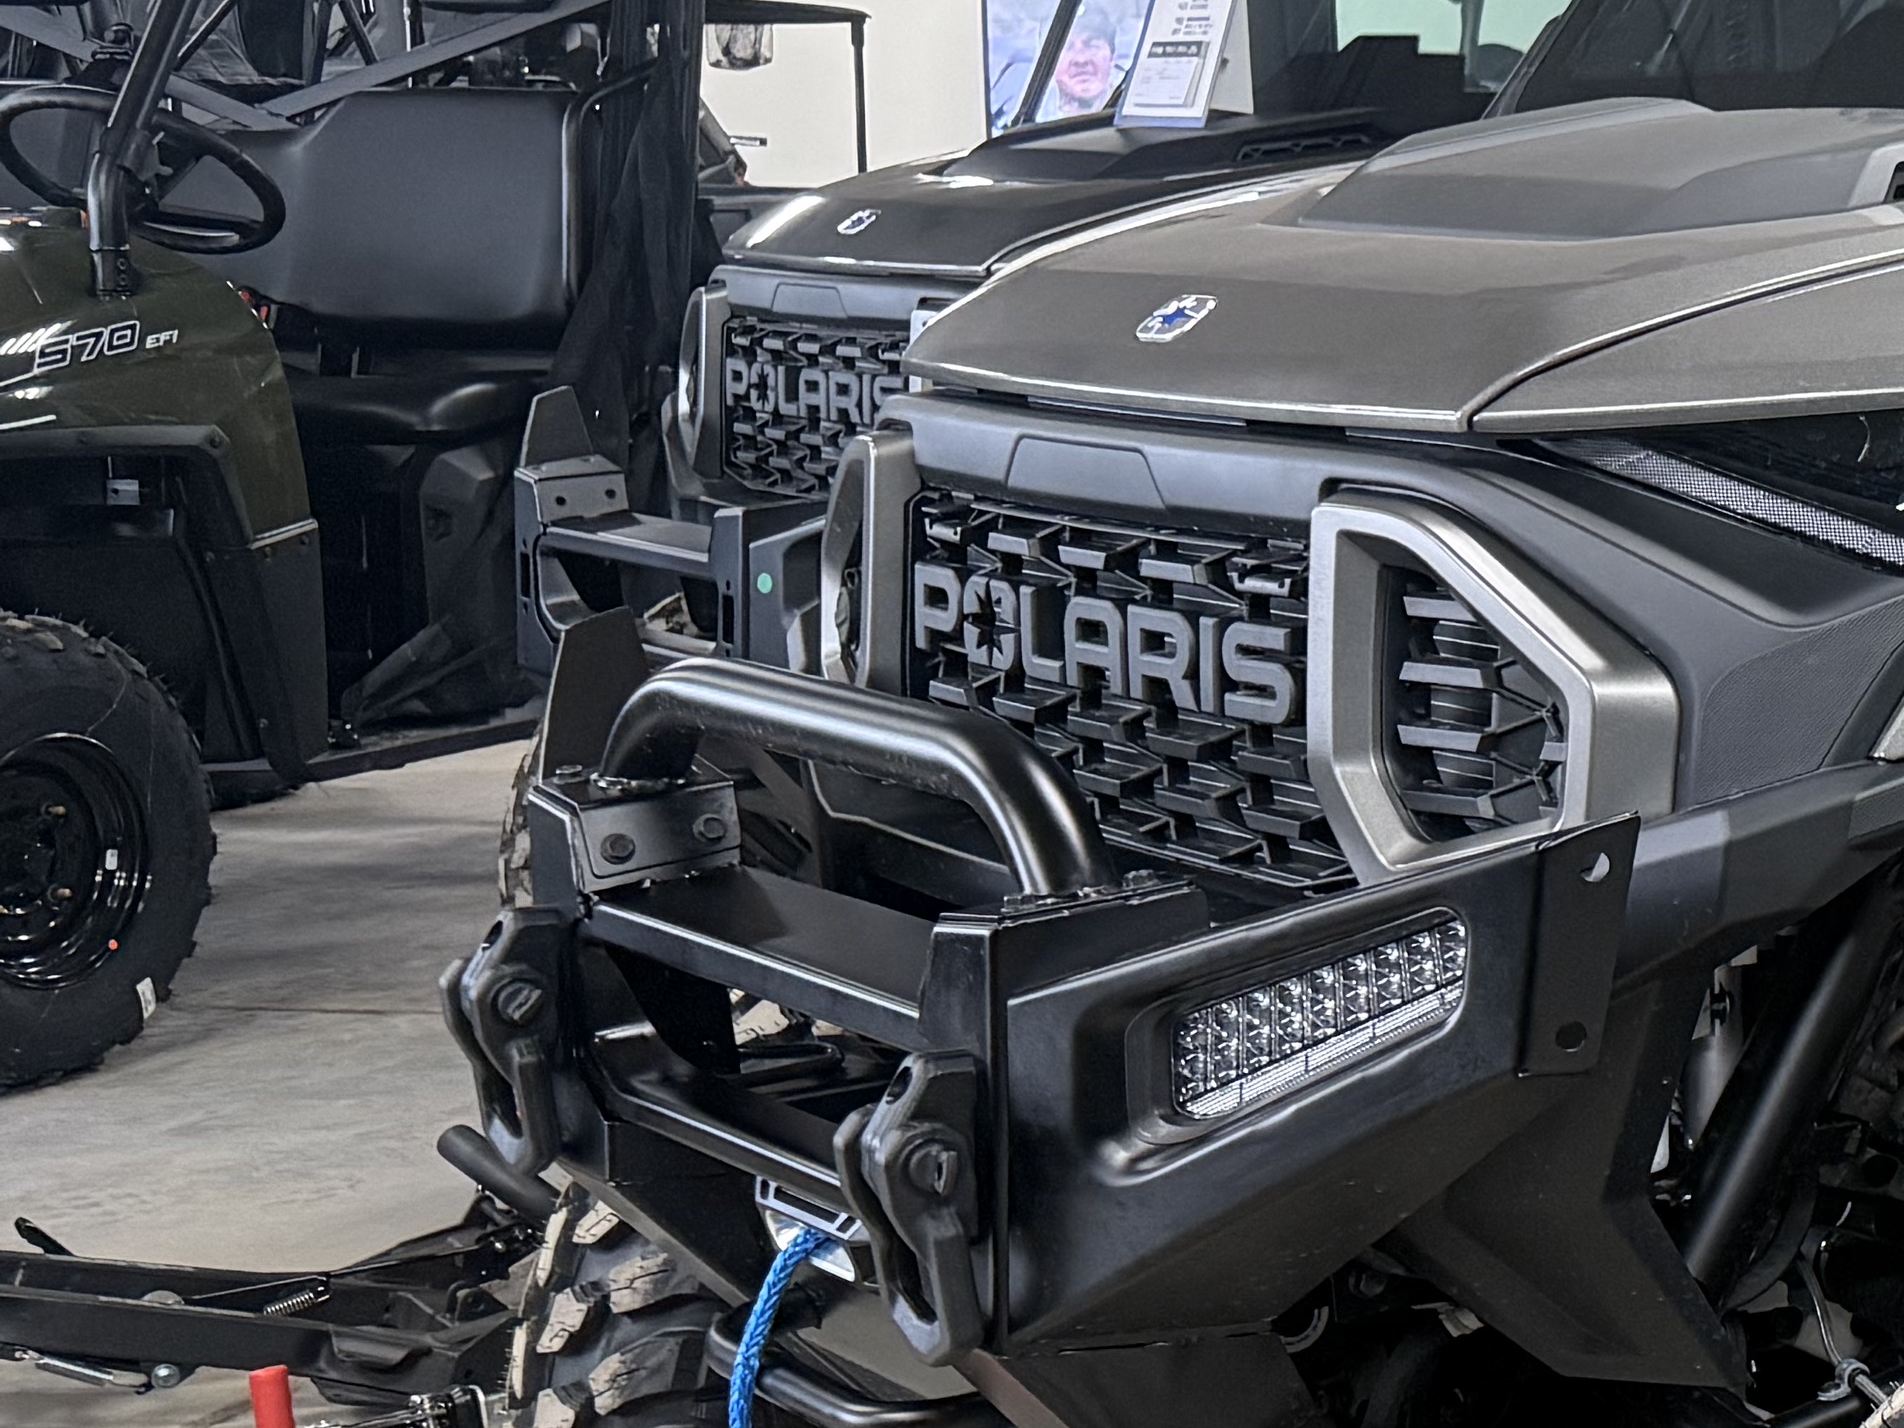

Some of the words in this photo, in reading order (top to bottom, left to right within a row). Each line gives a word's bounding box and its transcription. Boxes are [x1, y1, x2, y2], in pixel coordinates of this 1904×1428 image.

[34, 321, 140, 372] 570
[145, 330, 178, 349] EFI
[914, 561, 1297, 726] POLARIS
